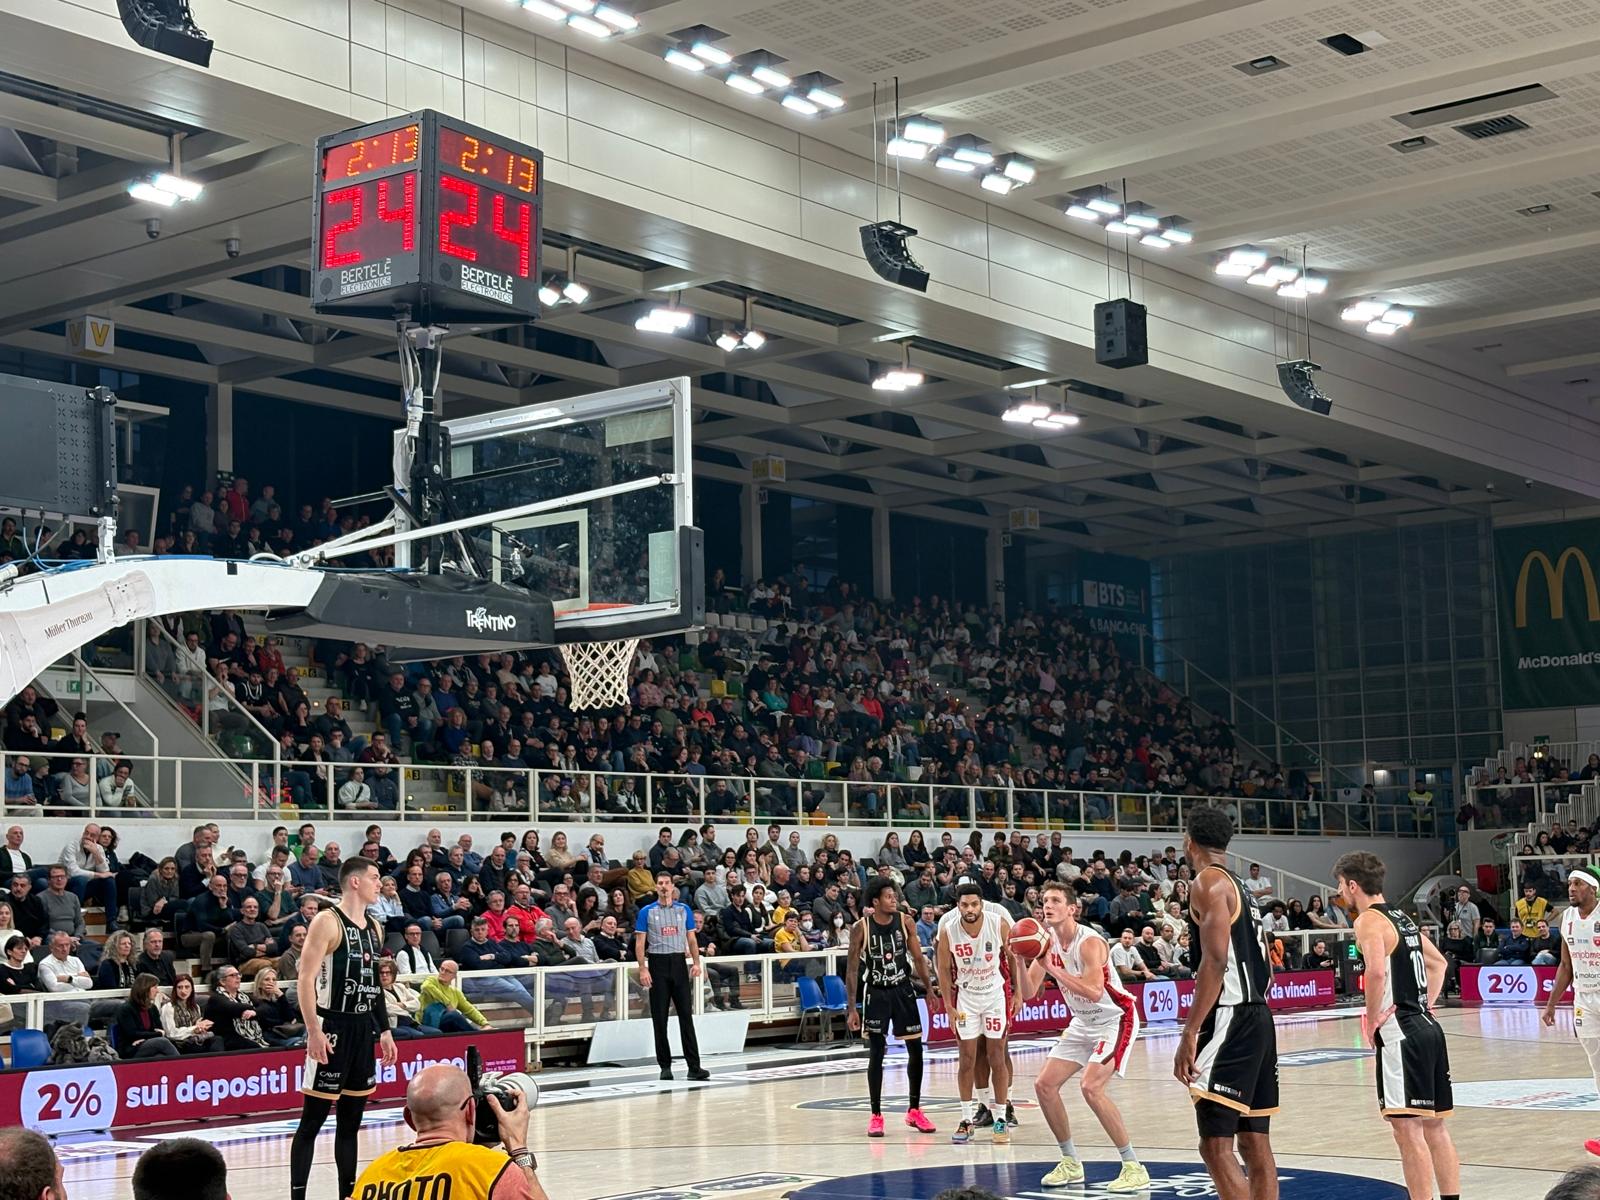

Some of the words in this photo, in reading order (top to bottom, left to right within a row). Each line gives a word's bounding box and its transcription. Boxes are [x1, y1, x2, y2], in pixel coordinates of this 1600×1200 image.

[347, 125, 418, 177] 2:13
[461, 136, 536, 193] 2:13
[324, 173, 416, 269] 24
[439, 174, 531, 278] 24
[341, 258, 391, 284] BERTELÈ
[461, 264, 513, 293] BERTELÈ
[341, 275, 391, 295] ELECTRONICS
[461, 279, 513, 304] ELECTRONICS
[91, 321, 110, 347] V
[1098, 582, 1124, 607] BTS
[44, 622, 66, 639] Müller
[65, 612, 94, 630] Thureau
[466, 608, 516, 632] TRENTINO
[1518, 652, 1600, 670] McDonald's
[347, 927, 358, 940] 23
[872, 934, 877, 945] 1
[1567, 921, 1573, 935] 1
[955, 943, 973, 957] 55
[1348, 944, 1355, 956] 3
[1409, 950, 1427, 987] 10
[1270, 982, 1283, 999] da
[1284, 979, 1316, 998] vincoli
[1487, 974, 1527, 993] 2%
[1015, 999, 1049, 1022] iberi
[1051, 999, 1067, 1018] da
[1149, 989, 1173, 1014] 2%
[932, 1014, 949, 1029] su
[985, 1017, 1001, 1031] 55
[37, 1079, 102, 1121] 2%
[126, 1075, 169, 1108] sui
[175, 1065, 287, 1106] depositi
